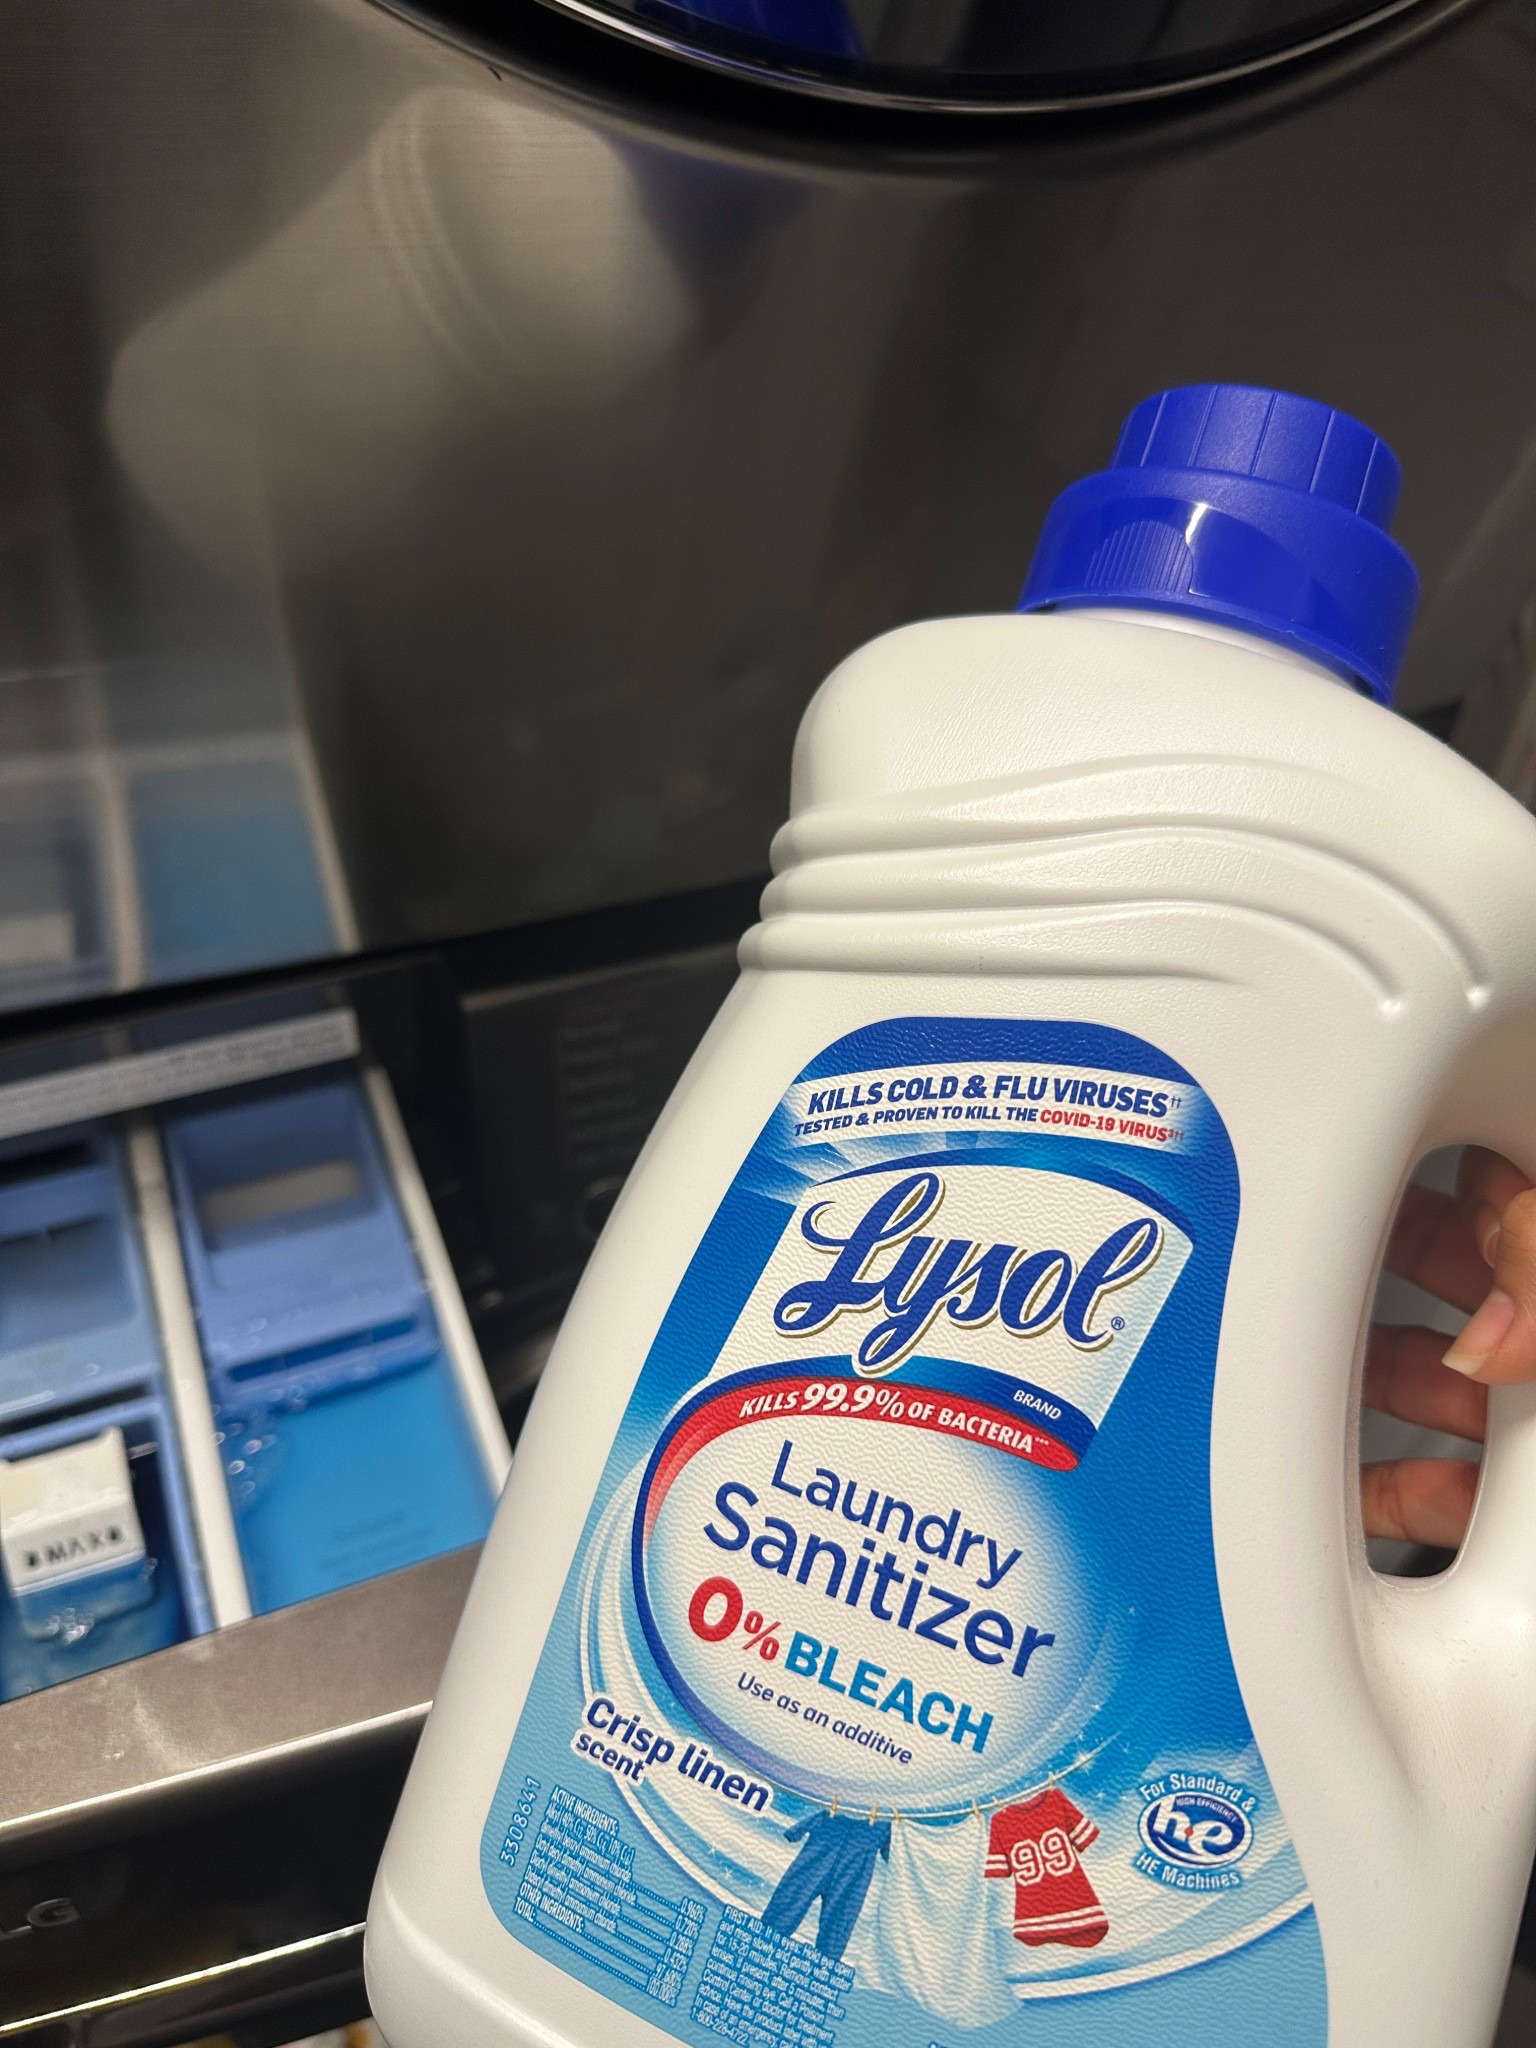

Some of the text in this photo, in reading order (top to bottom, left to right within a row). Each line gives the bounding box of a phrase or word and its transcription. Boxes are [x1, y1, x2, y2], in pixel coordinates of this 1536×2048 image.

[807, 1082, 884, 1115] KILLS
[887, 1077, 958, 1103] COLD
[962, 1075, 988, 1099] &
[992, 1075, 1050, 1101] FLU
[794, 1114, 853, 1137] TESTED
[855, 1112, 870, 1126] &
[873, 1107, 937, 1124] PROVEN
[941, 1106, 962, 1120] TO
[964, 1105, 1000, 1121] KILL
[1010, 1107, 1038, 1122] THE
[1040, 1109, 1115, 1132] COVID-19
[739, 1389, 798, 1420] KILLS
[802, 1382, 906, 1420] 99.9%
[908, 1401, 935, 1422] OF
[1013, 1389, 1062, 1420] BRAND
[771, 1440, 1022, 1590] Laundry
[703, 1481, 1055, 1678] Sanitizer
[688, 1575, 994, 1753] 0% BLEACH
[737, 1671, 913, 1764] Use as an additive
[576, 1734, 645, 1782] scent
[586, 1697, 769, 1812] Crisp linen
[552, 1786, 619, 1835] ACTIVE INGREDIENTS:
[1139, 1773, 1256, 1812] For Standard &
[499, 1776, 541, 1867] 3308641
[1011, 1829, 1077, 1887] 99
[1136, 1852, 1239, 1889] HE Machines
[0, 1897, 80, 1940] LG
[514, 1898, 536, 1921] TOTAL:
[519, 1882, 541, 1905] OTHER
[540, 1895, 584, 1932] INGREDIENTS:
[720, 1921, 733, 1933] and
[751, 1936, 775, 1957] slowly
[775, 1948, 790, 1962] and
[813, 1965, 829, 1980] with
[830, 1975, 851, 1991] water
[724, 1906, 747, 1925] FIRST
[747, 1918, 764, 1934] AID:
[772, 1931, 780, 1941] in
[802, 1945, 820, 1961] Hold
[820, 1957, 833, 1970] eye
[834, 1962, 853, 1978] open
[727, 1937, 749, 1956] 15-20
[780, 1965, 810, 1987] Remove
[703, 1969, 729, 1990] Control
[729, 1982, 752, 2002] Center
[752, 1996, 761, 2007] or
[724, 1994, 742, 2012] Have
[778, 1992, 792, 2007] Call
[792, 2002, 797, 2011] a
[798, 2002, 824, 2023] Poison
[788, 1983, 795, 1993] 5
